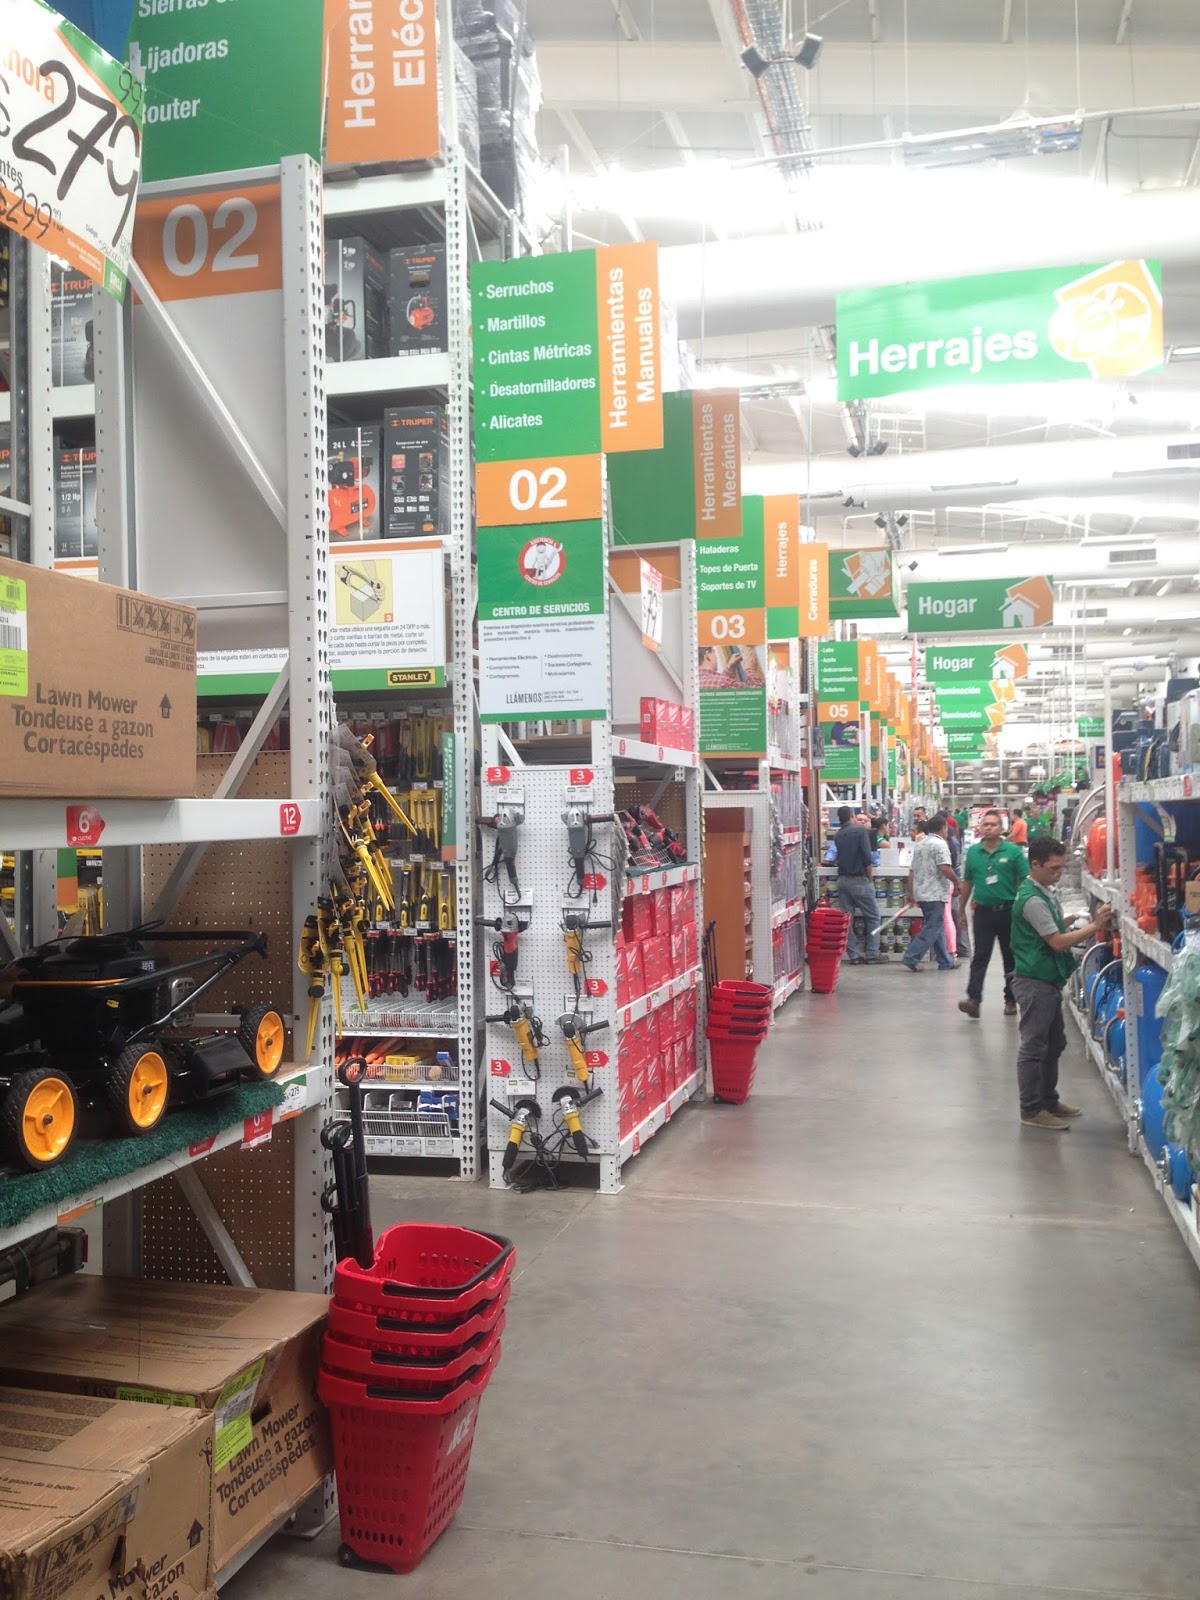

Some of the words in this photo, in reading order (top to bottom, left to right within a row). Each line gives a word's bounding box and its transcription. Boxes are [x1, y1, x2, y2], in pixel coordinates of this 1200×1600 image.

[140, 39, 229, 73] Lijadoras
[12, 60, 140, 248] 279
[162, 197, 260, 278] 02
[486, 280, 554, 299] Serruchos
[488, 314, 546, 332] Martillos
[488, 348, 530, 365] Cintas
[533, 342, 592, 361] Métricas
[607, 267, 628, 428] Herramientas
[634, 287, 656, 404] Manuales
[848, 327, 1039, 377] Herrajes
[490, 378, 597, 397] Desatornilladores
[401, 418, 434, 426] TRUPER
[490, 413, 543, 430] Alicates
[701, 402, 715, 521] Herramientas
[722, 412, 736, 508] Mecánicas
[509, 467, 568, 511] 02
[700, 545, 740, 554] Haladeras
[776, 521, 788, 578] Herrajes
[700, 565, 721, 574] Topes
[722, 564, 732, 572] de
[734, 563, 758, 572] Puerta
[701, 582, 734, 592] Soportes
[746, 580, 756, 589] TV
[808, 559, 818, 622] Cerraduras
[492, 606, 527, 617] CENTRO
[530, 604, 542, 614] DE
[543, 602, 590, 613] SERVICIOS
[918, 596, 978, 618] Hogar
[711, 614, 746, 640] 03
[932, 656, 975, 672] Hogar
[392, 673, 429, 682] STANLEY
[36, 683, 82, 708] Lawn
[88, 690, 138, 715] Mower
[506, 692, 542, 704] LLÁMENOS
[936, 686, 981, 696] Iluminación
[829, 704, 849, 718] 05
[12, 703, 94, 732] Tondeuse
[112, 719, 154, 742] gazon
[23, 731, 145, 764] Cortacéspedes
[494, 768, 502, 778] 3
[577, 770, 584, 779] 3
[79, 810, 90, 834] 6
[284, 806, 296, 825] 12
[591, 980, 599, 991] 3
[494, 1062, 502, 1072] 3
[592, 1052, 600, 1063] 3
[229, 1438, 260, 1473] Lawn
[261, 1402, 299, 1444] Mower
[446, 1410, 474, 1456] ACE
[216, 1448, 272, 1503] Tondeuse
[284, 1412, 319, 1452] gazon
[228, 1434, 316, 1516] Cortacéspedes
